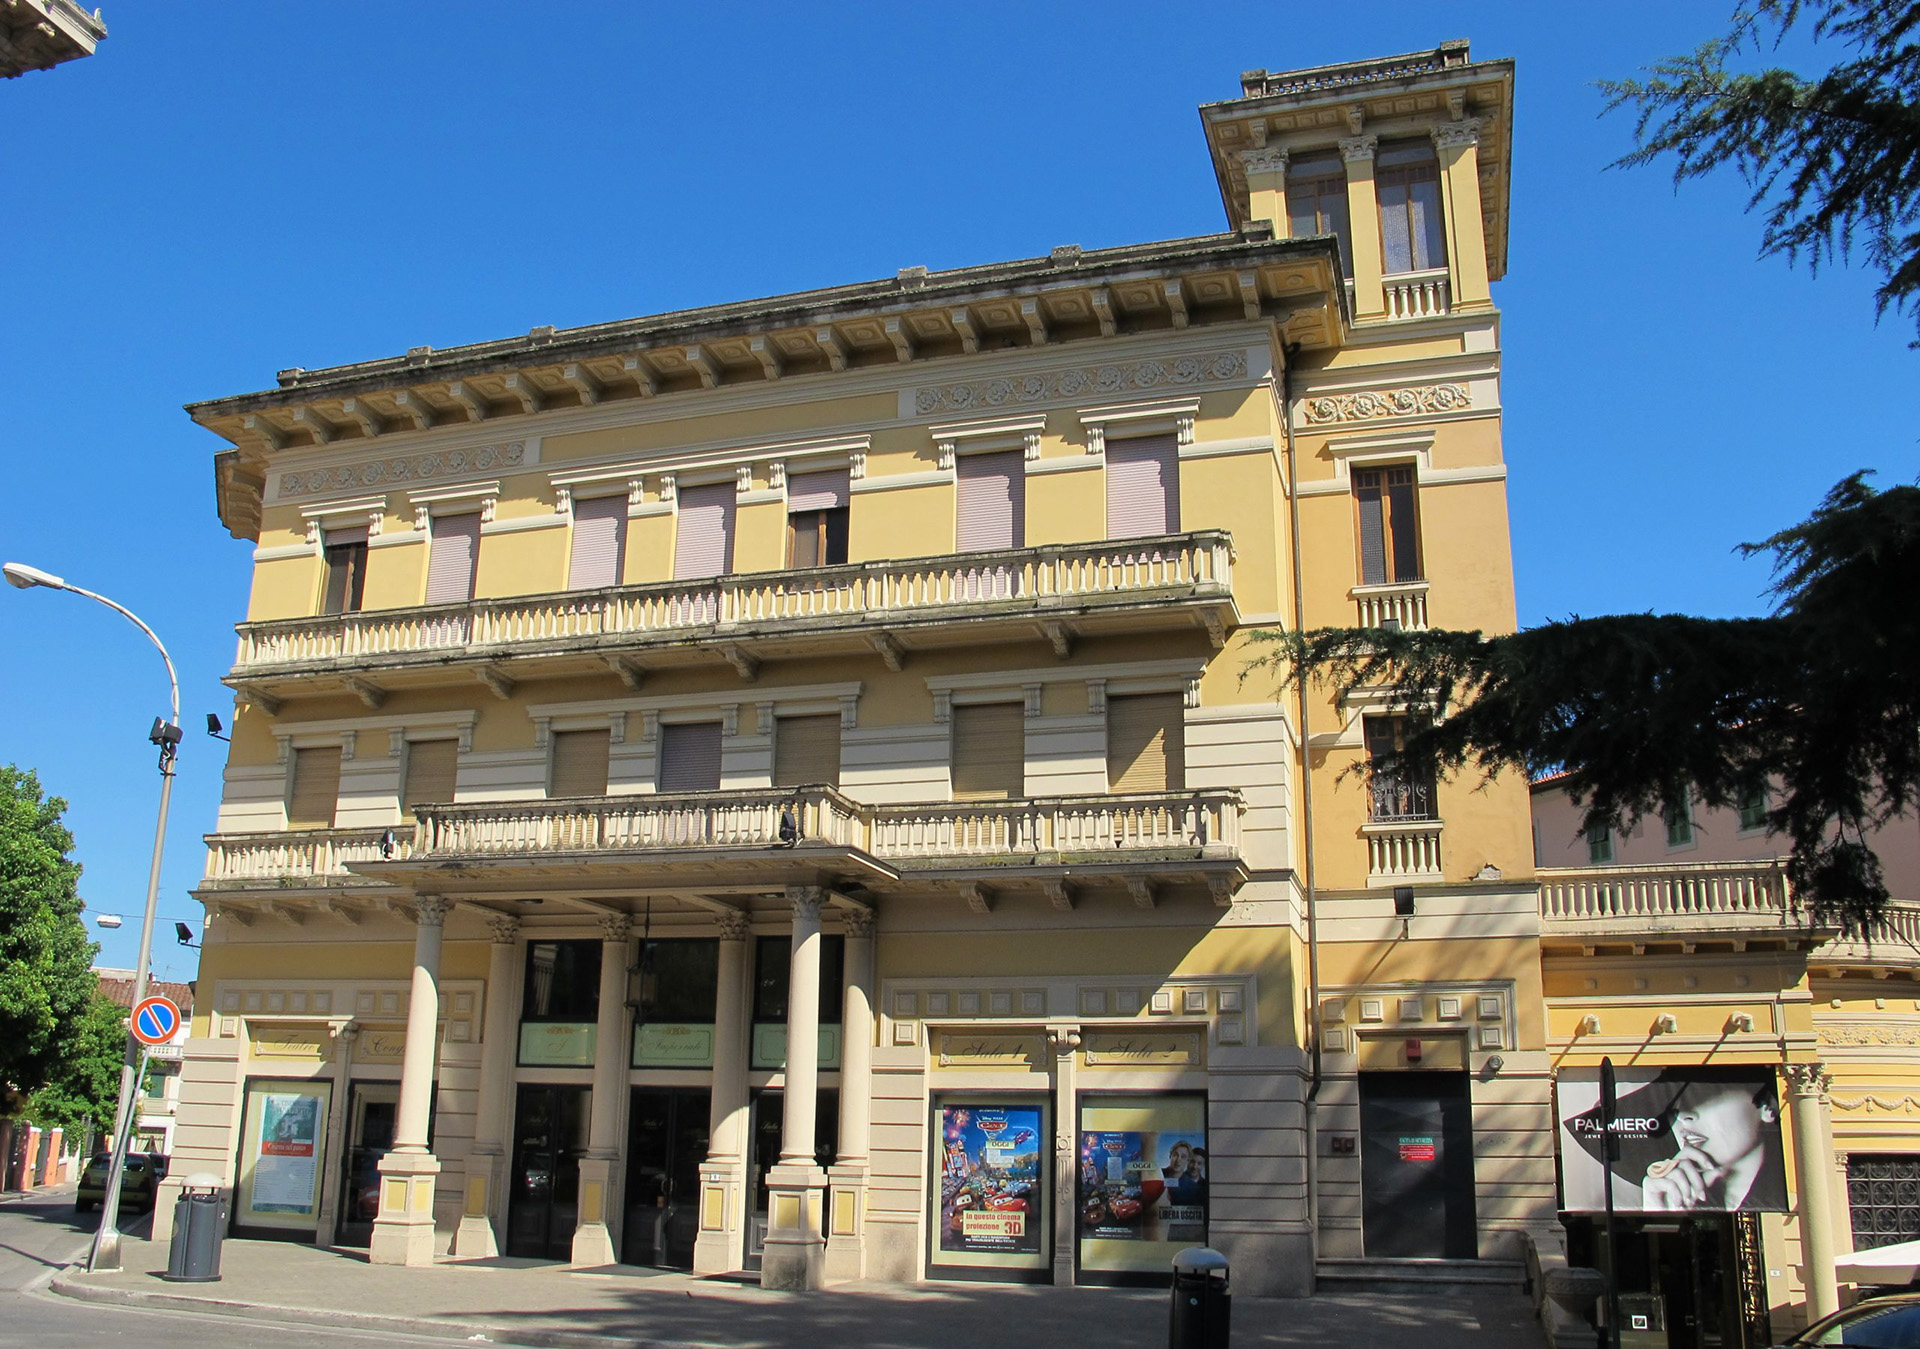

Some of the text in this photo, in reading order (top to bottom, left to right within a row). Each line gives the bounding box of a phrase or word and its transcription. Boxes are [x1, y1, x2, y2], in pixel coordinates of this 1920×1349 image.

[274, 1034, 316, 1051] Teatro
[962, 1041, 1024, 1059] Sala 1
[1108, 1038, 1176, 1059] Sala 2
[1574, 1118, 1660, 1131] PALMIERO
[973, 1213, 996, 1221] questo
[965, 1221, 1022, 1235] proiezione 3D
